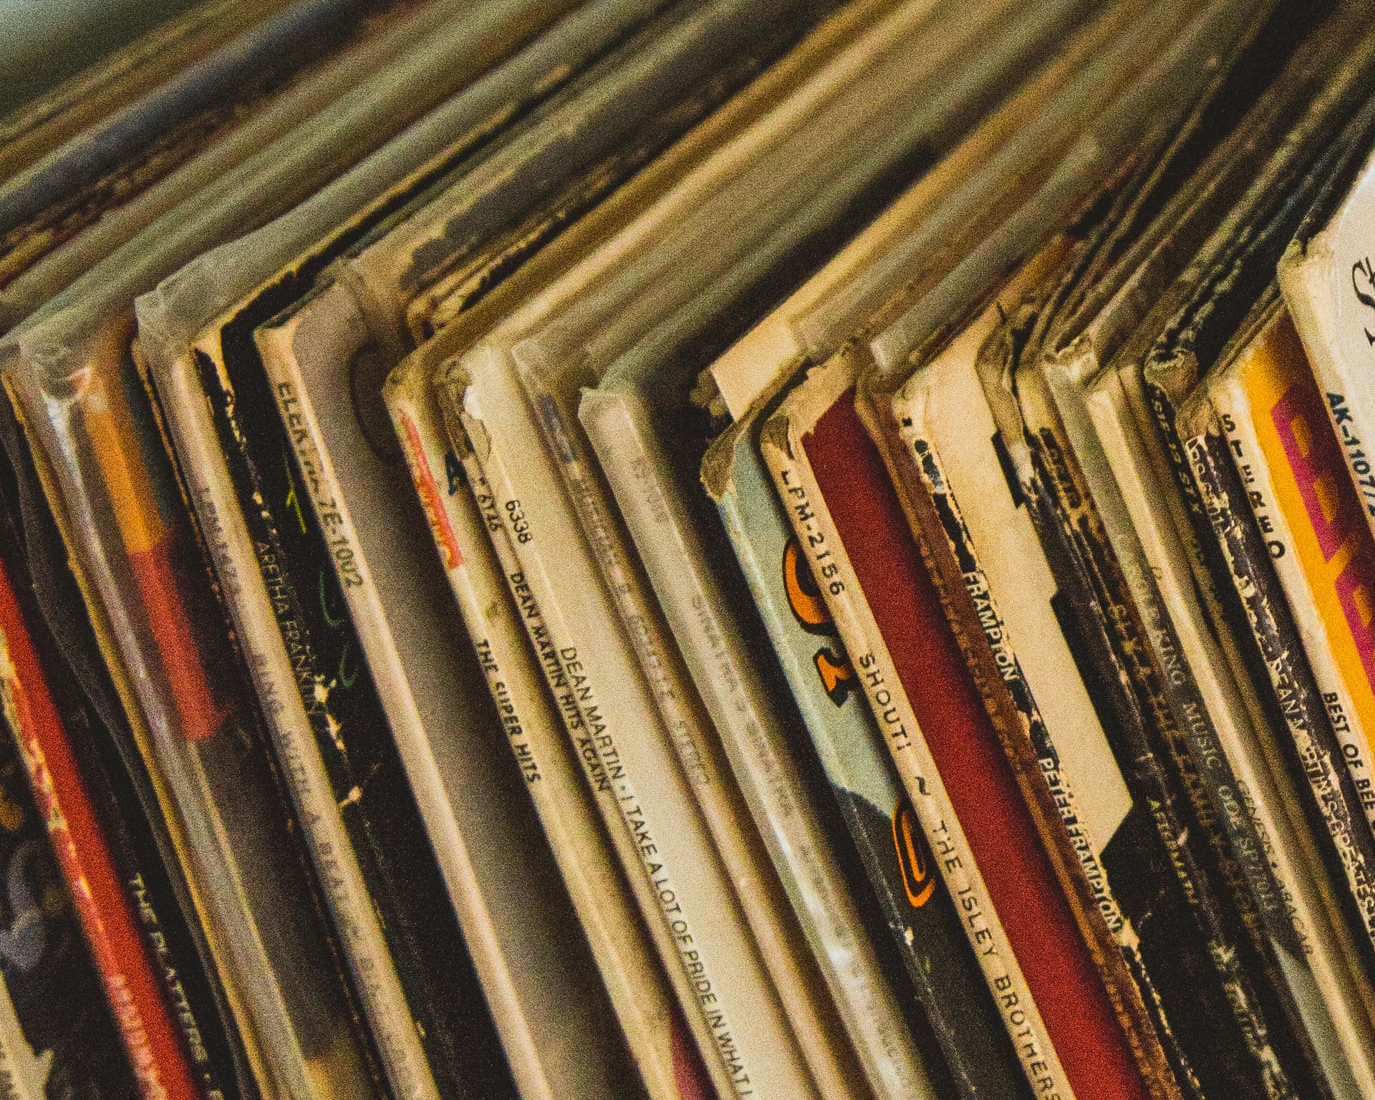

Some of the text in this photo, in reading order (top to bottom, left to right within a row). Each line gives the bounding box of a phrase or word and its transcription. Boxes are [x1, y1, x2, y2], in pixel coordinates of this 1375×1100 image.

[1222, 413, 1285, 559] STEREO
[503, 499, 532, 543] 6338
[779, 468, 845, 596] LPM-2156
[255, 538, 326, 715] ARETHA FRANKLIN
[509, 571, 610, 793] DEAN MARTIN HITS AGAIN
[559, 645, 595, 703] DEAN
[473, 638, 501, 676] THE
[514, 741, 544, 784] HITS
[1152, 626, 1186, 685] KING
[1182, 700, 1220, 770] MUSIC
[1217, 784, 1244, 829] ODE
[1321, 691, 1350, 735] BEST
[1339, 740, 1364, 773] OF
[583, 707, 626, 781] MARTIN
[281, 731, 311, 795] WITH
[306, 809, 323, 826] A
[858, 652, 911, 751] SHOUT!
[931, 821, 961, 872] THE
[957, 886, 998, 959] ISLEY
[1037, 755, 1075, 819] PETER
[627, 806, 657, 857] TAKE
[127, 872, 157, 926] THE
[646, 858, 664, 876] A
[654, 876, 680, 918] LOT
[669, 917, 693, 948] OF
[682, 948, 716, 1006] PRIDE
[705, 1006, 727, 1031] IN
[715, 1031, 749, 1087] WHAT
